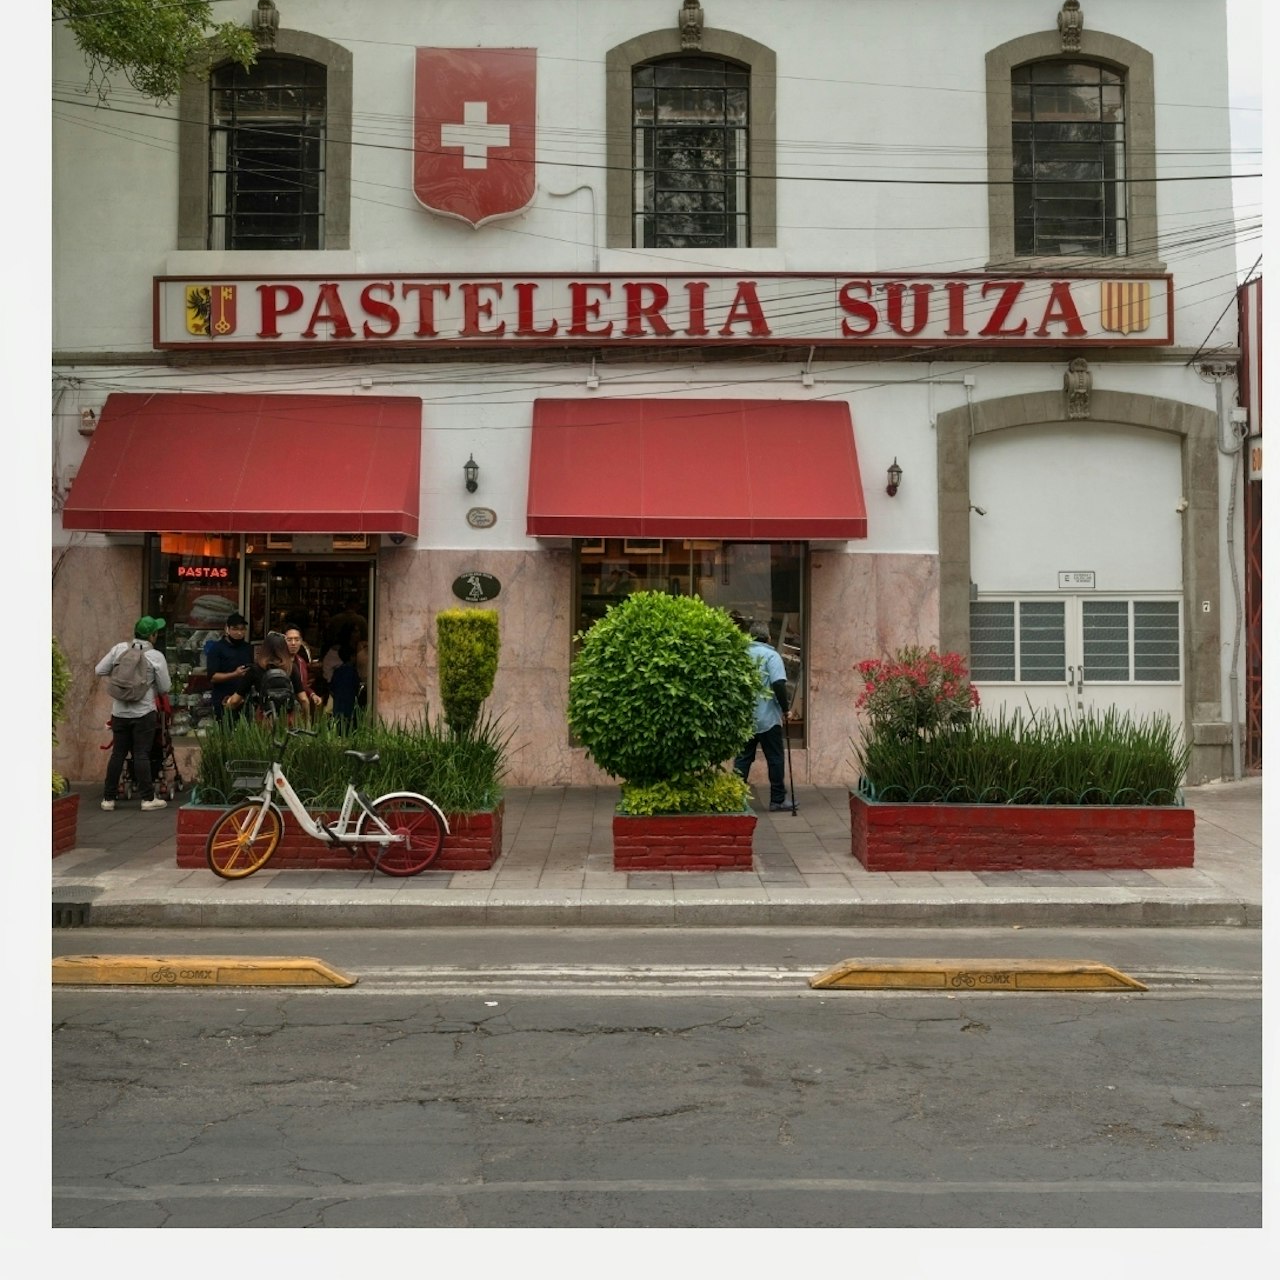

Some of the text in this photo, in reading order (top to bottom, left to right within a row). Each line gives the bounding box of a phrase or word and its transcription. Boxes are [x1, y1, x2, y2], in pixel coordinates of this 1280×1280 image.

[255, 280, 1088, 339] PASTELERIA SUIZA
[177, 566, 229, 578] PASTAS
